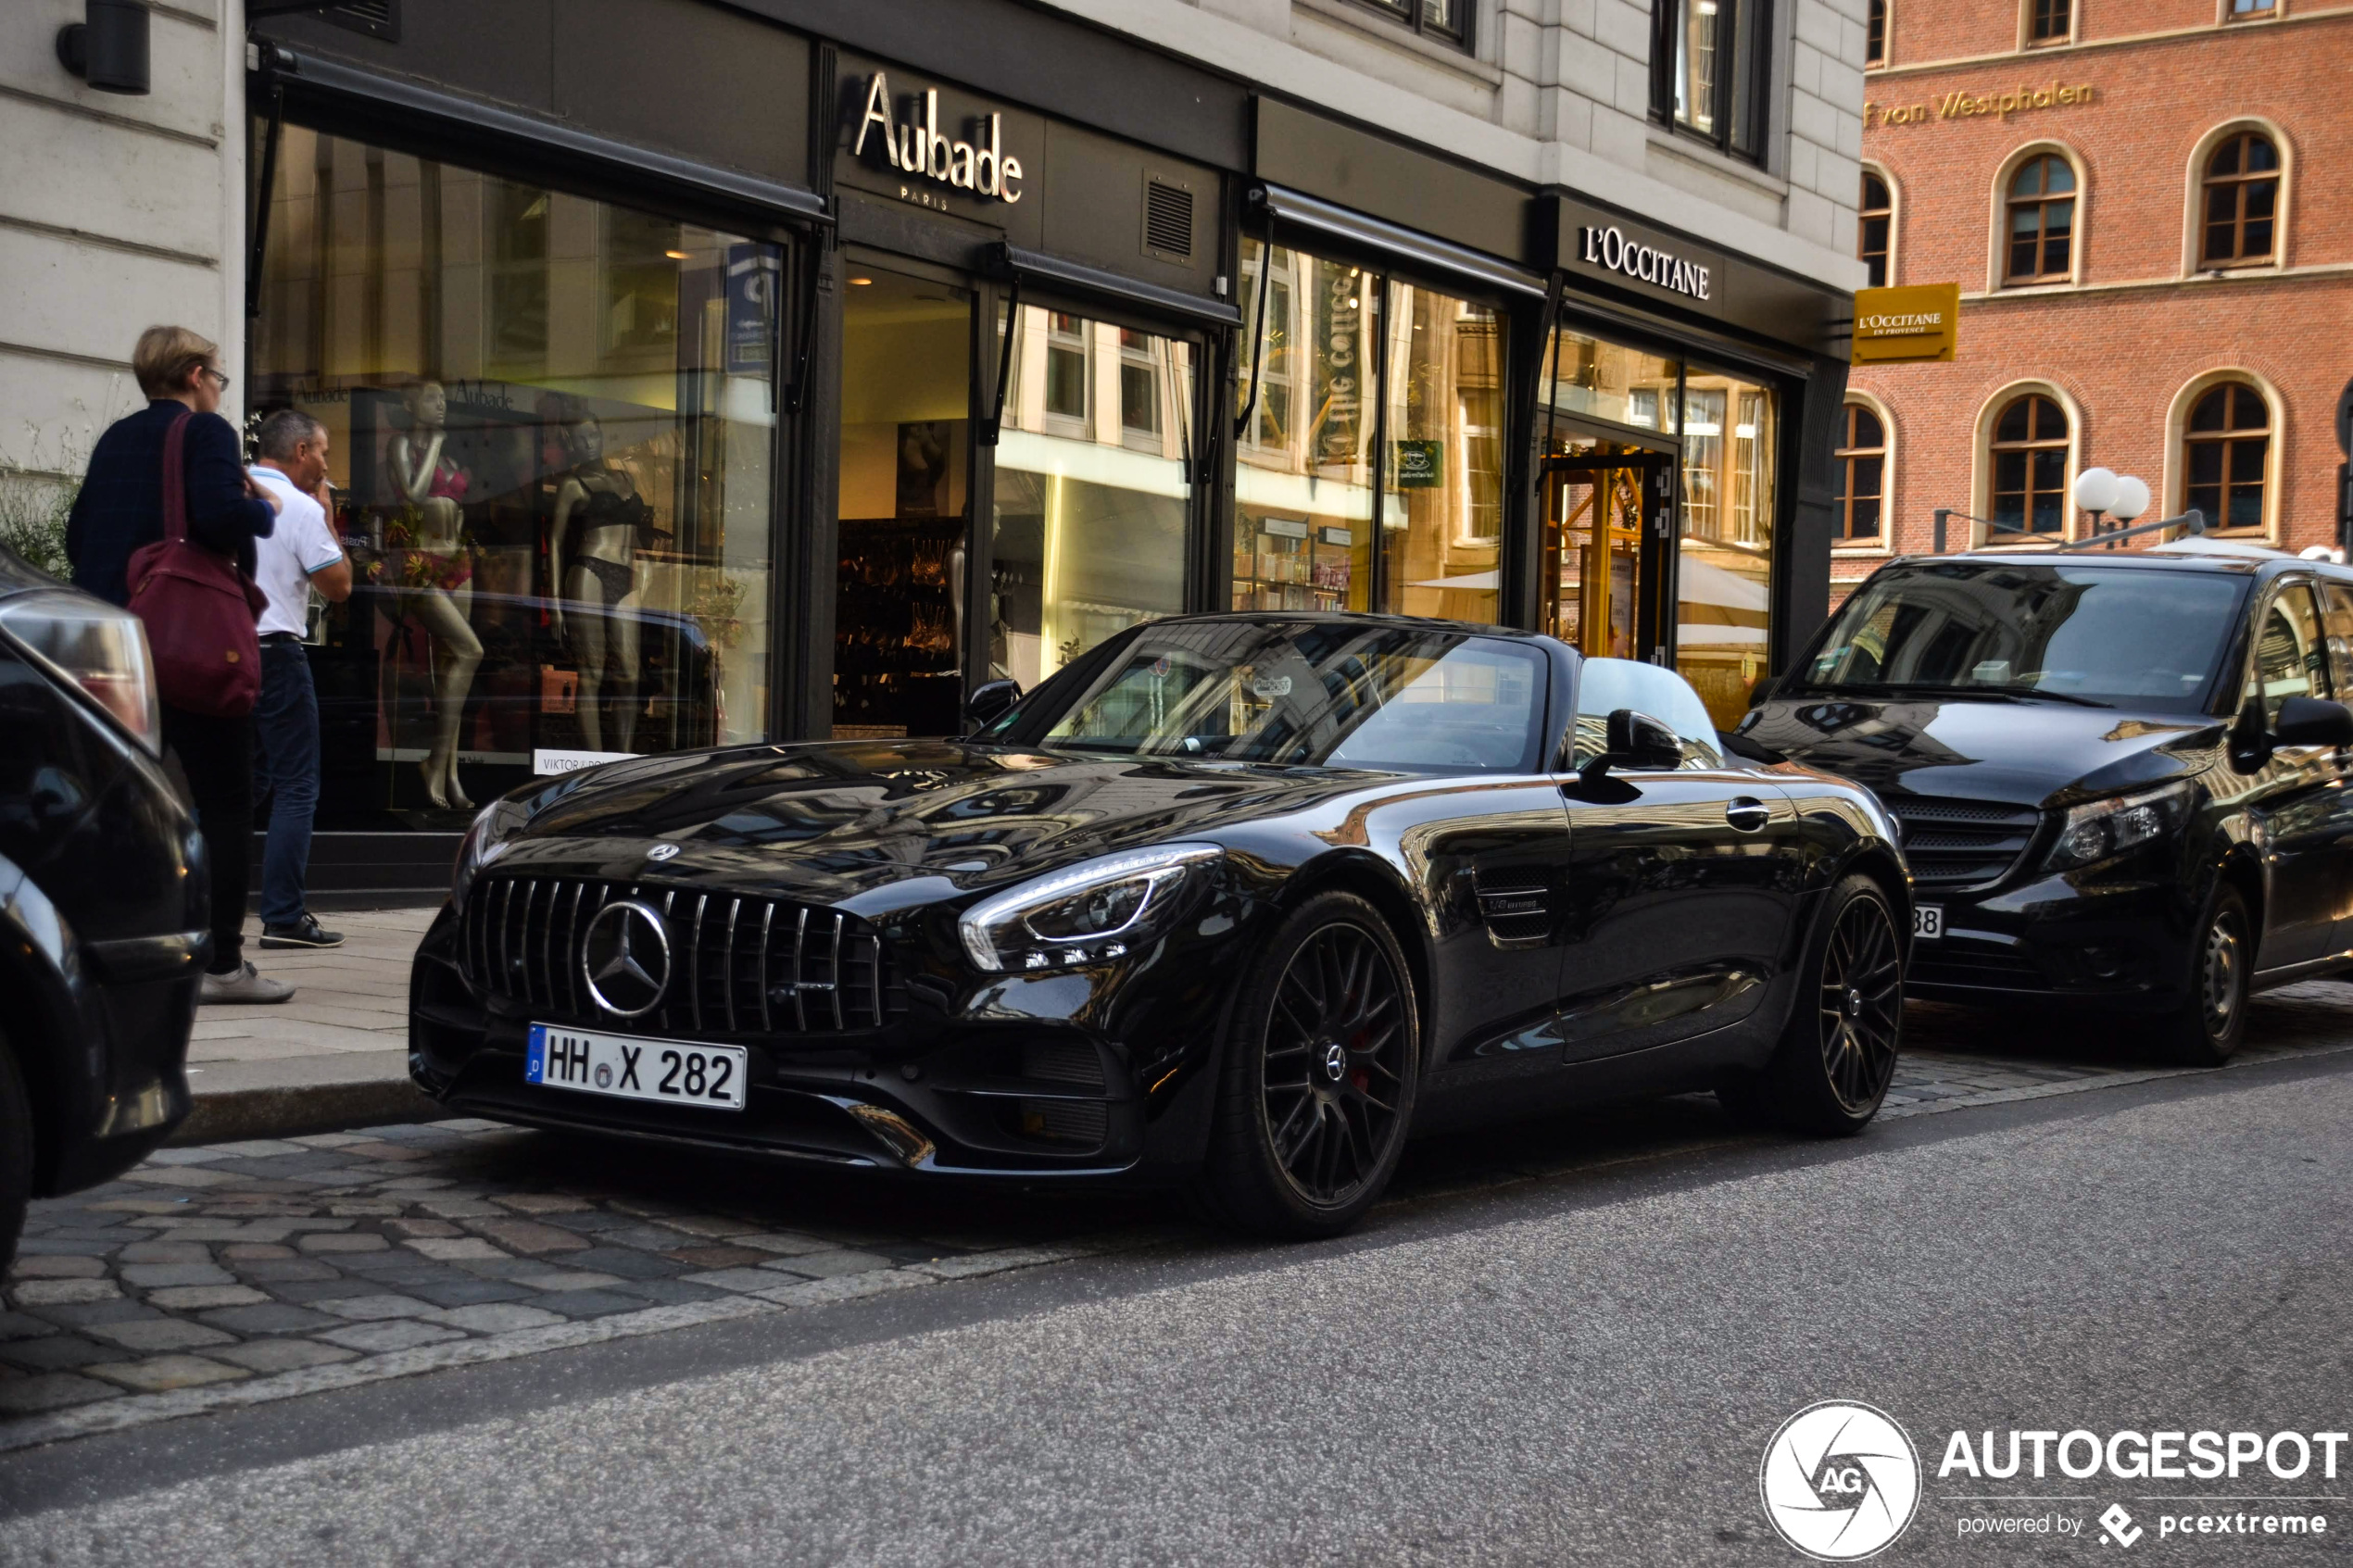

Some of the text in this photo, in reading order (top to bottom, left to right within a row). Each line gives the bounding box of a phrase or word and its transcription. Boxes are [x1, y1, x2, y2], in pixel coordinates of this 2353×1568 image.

[1880, 102, 1926, 124] von
[1931, 80, 2095, 121] Westphalen
[855, 71, 1023, 204] Aubade
[900, 186, 947, 211] PARIS
[1584, 226, 1711, 301] L'OCCITANE
[1858, 313, 1942, 329] L'OCCITANE
[1885, 327, 1926, 335] PROVENCE
[296, 377, 349, 405] Aubade
[454, 379, 514, 409] Aubade
[532, 1060, 539, 1073] D
[548, 1035, 733, 1100] HH X 282
